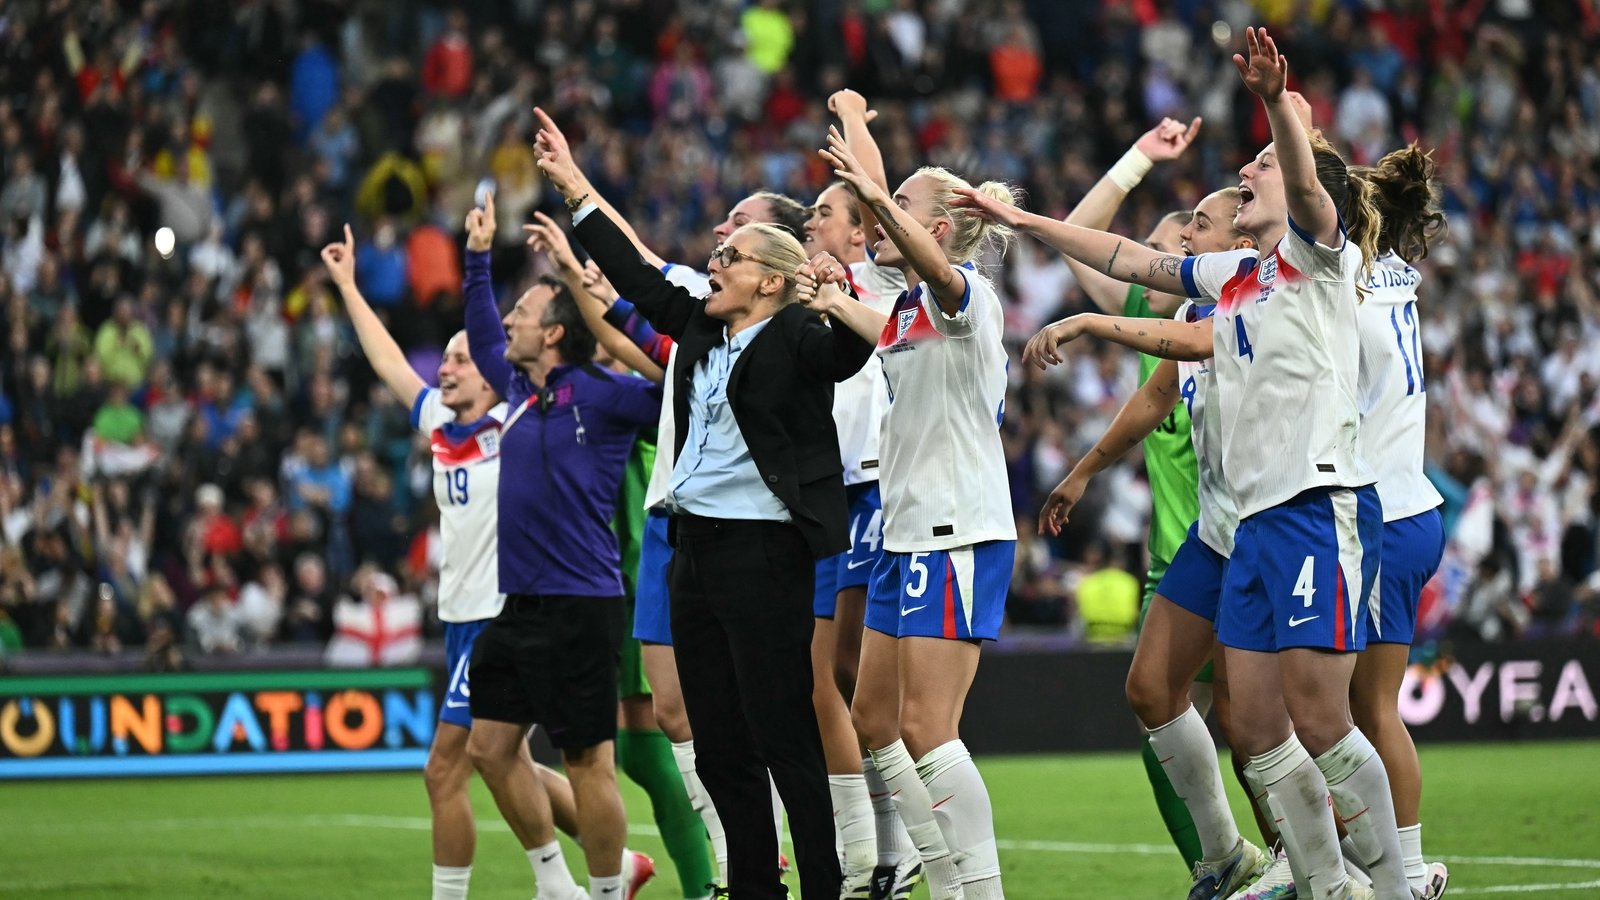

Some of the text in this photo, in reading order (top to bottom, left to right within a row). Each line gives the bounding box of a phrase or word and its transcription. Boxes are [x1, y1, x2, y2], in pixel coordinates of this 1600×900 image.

[1235, 314, 1254, 364] 4
[1391, 300, 1425, 396] 12
[446, 467, 469, 505] 19
[847, 509, 882, 554] 14
[906, 553, 929, 598] 5
[1292, 555, 1317, 608] 4
[0, 690, 434, 757] OUNDATION
